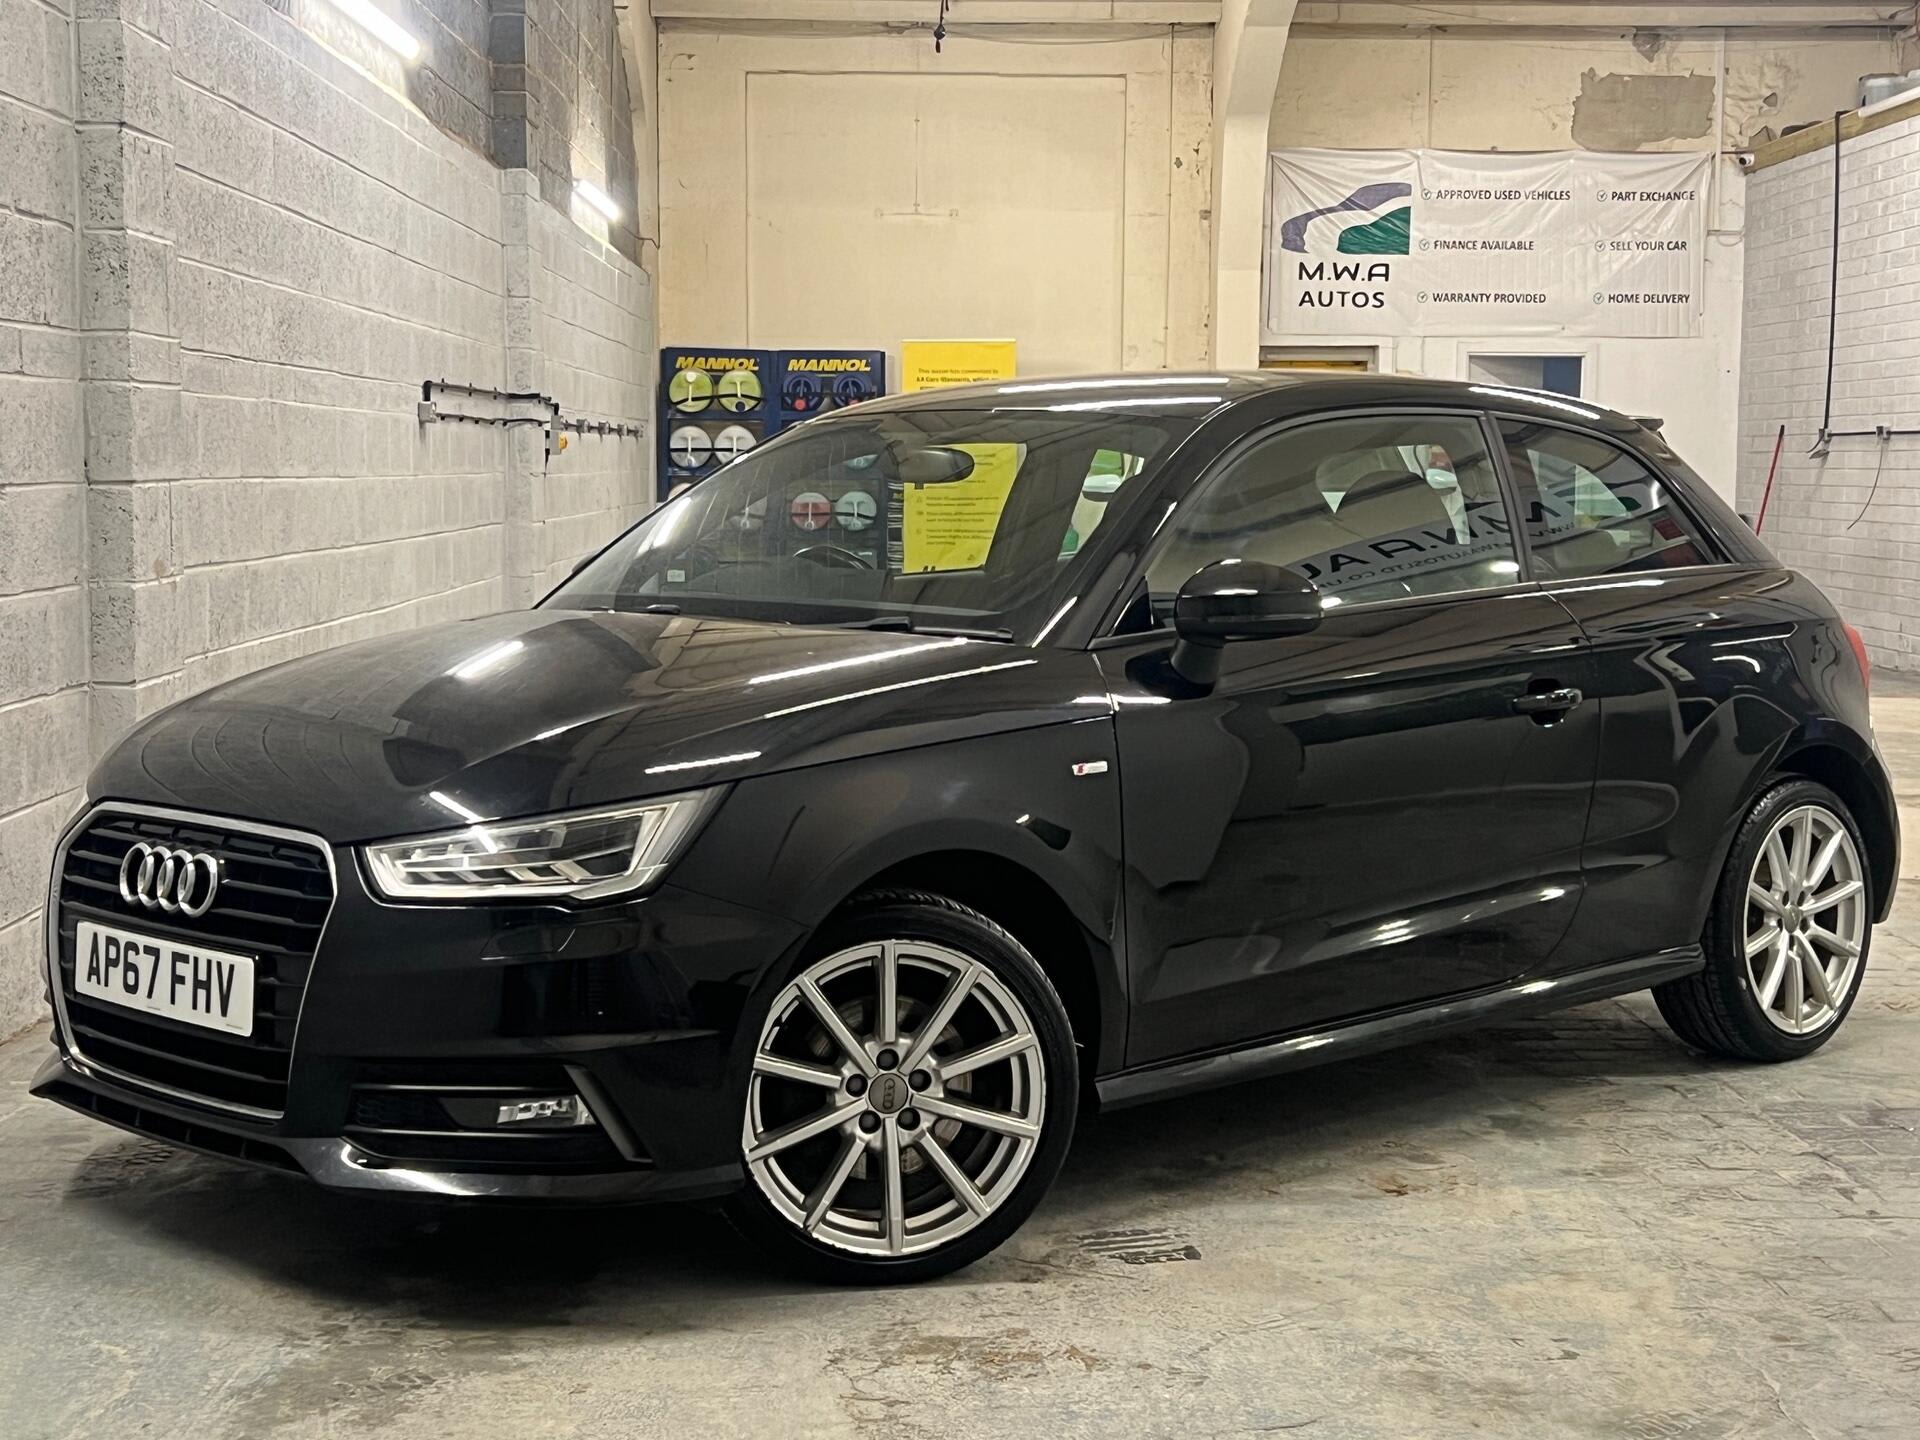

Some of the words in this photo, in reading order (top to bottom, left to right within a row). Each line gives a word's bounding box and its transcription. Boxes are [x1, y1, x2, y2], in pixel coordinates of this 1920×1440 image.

[1436, 189, 1491, 200] APPROVED
[1494, 190, 1521, 201] USED
[1523, 190, 1570, 201] VEHICLES
[1612, 191, 1637, 202] PART
[1639, 191, 1695, 202] EXCHANGE
[1434, 240, 1477, 251] FINANCE
[1480, 240, 1534, 251] AVAILABLE
[1610, 241, 1632, 251] SELL
[1634, 241, 1664, 251] YOUR
[1666, 241, 1687, 251] CAR
[1298, 262, 1390, 283] M.W.A
[1298, 291, 1385, 308] AUTOS
[1433, 293, 1491, 304] WARRANTY
[1494, 293, 1546, 303] PROVIDED
[1608, 293, 1641, 304] HOME
[1644, 293, 1690, 304] DELIVERY
[675, 356, 759, 371] MANNOL
[787, 358, 871, 372] MANNOL
[86, 931, 160, 999] AP67
[169, 951, 235, 1018] FHV
